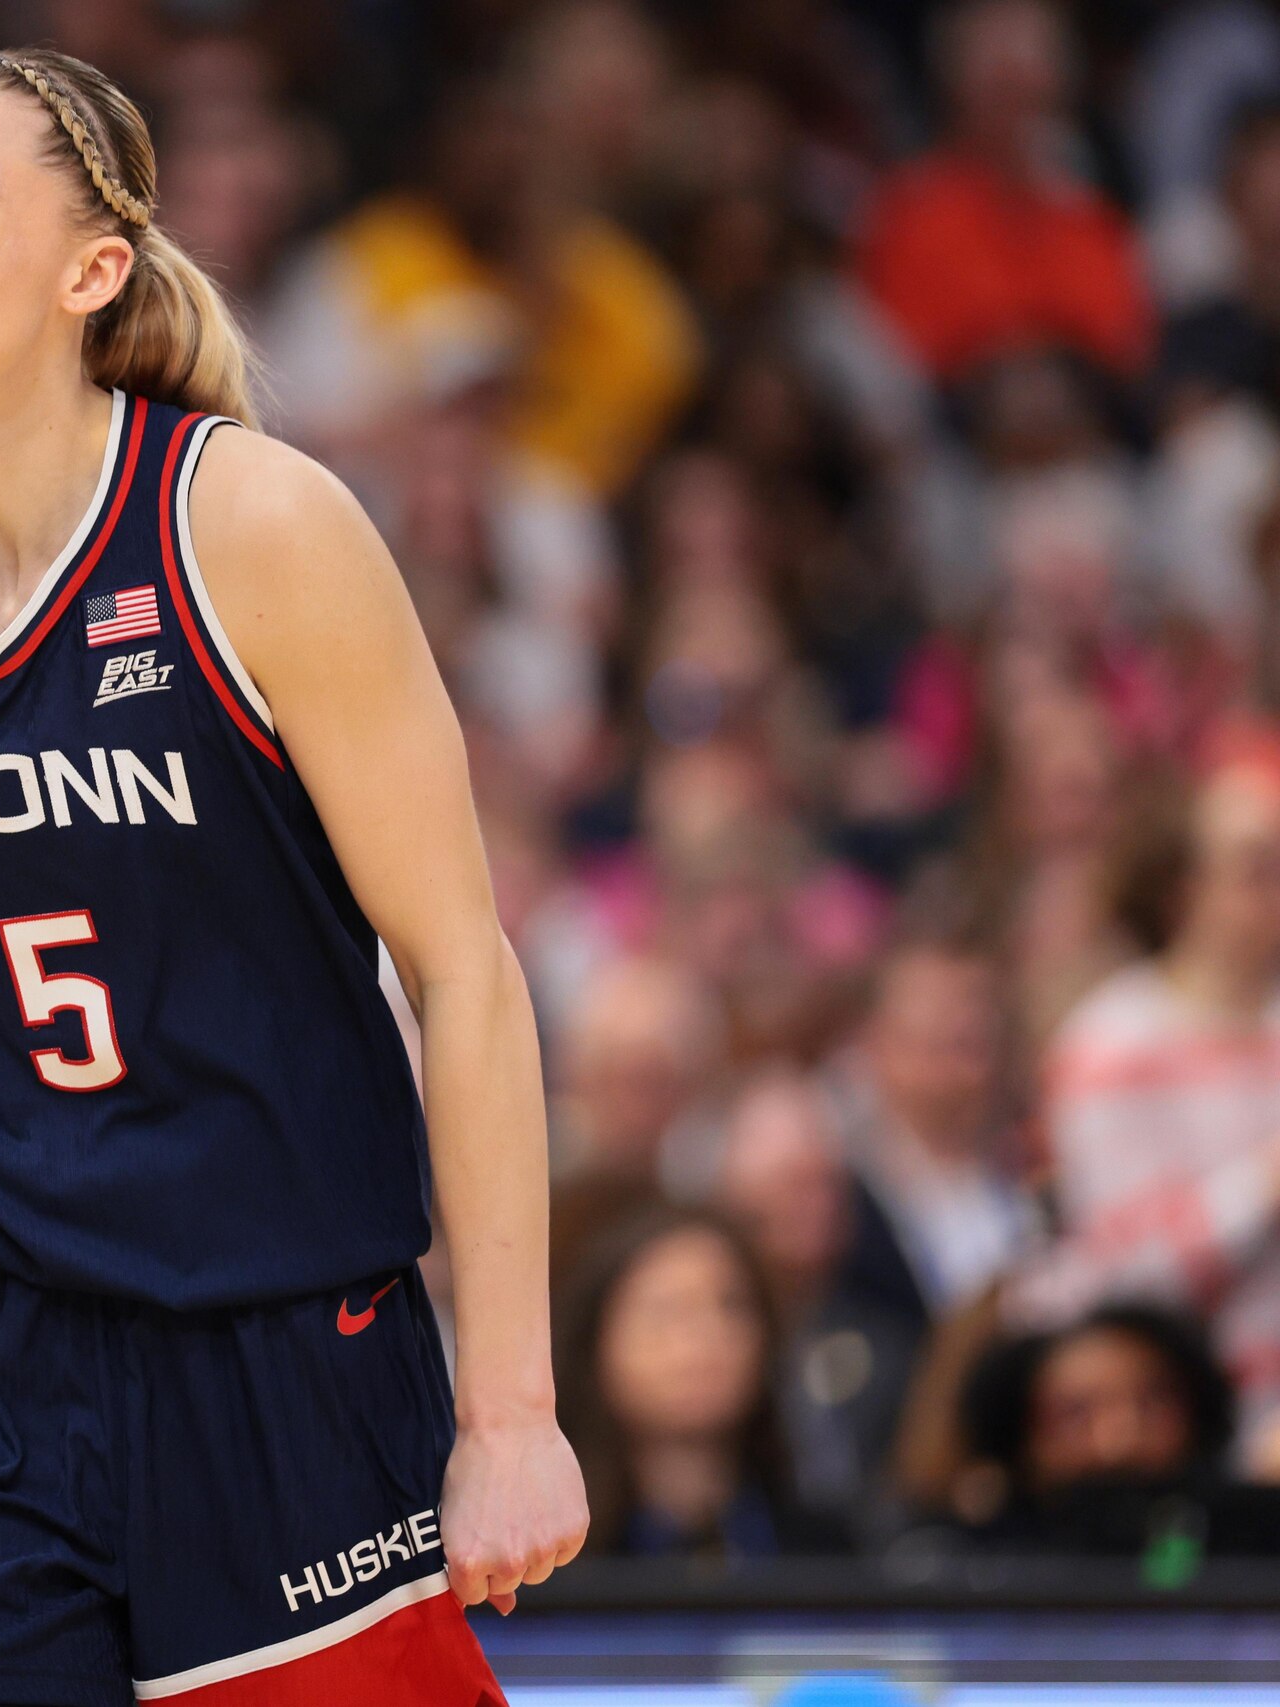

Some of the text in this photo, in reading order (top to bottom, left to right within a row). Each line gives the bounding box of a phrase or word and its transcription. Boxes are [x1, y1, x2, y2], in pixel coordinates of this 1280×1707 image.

[102, 649, 157, 678] BIG
[97, 664, 175, 697] EAST
[279, 1503, 441, 1613] HUSKIE
